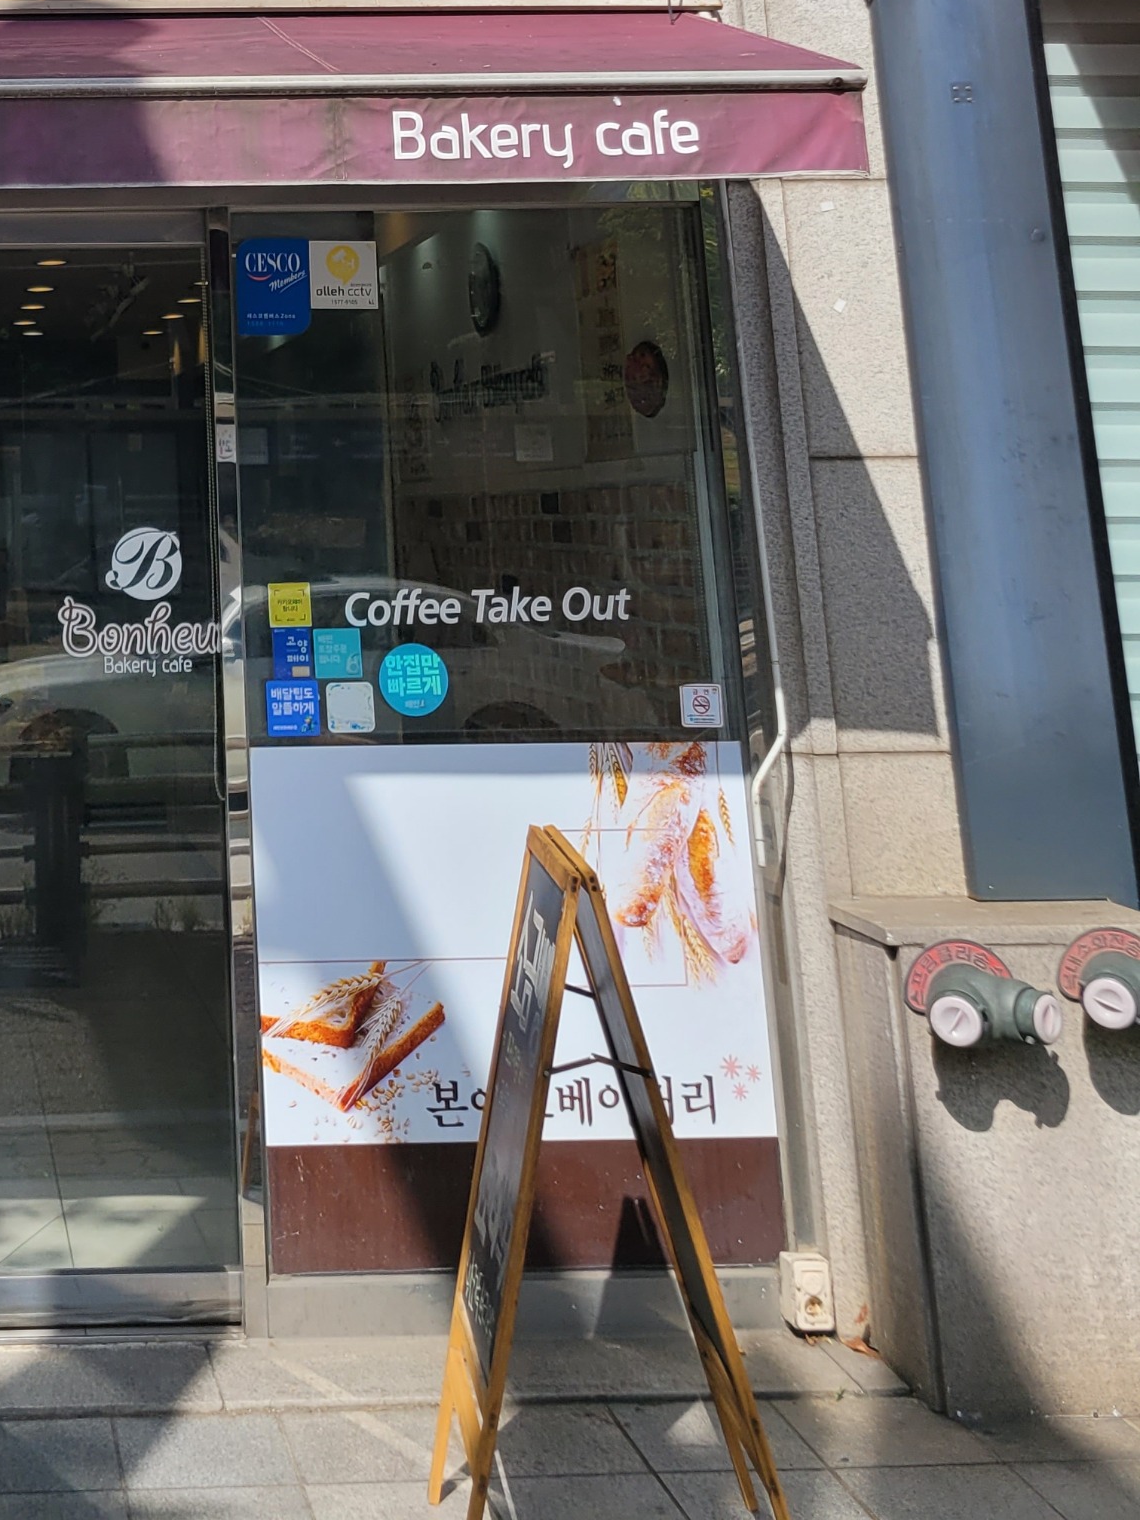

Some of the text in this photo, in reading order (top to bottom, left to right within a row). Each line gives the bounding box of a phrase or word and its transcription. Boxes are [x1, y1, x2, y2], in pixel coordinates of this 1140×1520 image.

[392, 109, 700, 169] Bakery cafe
[245, 252, 301, 273] CESCO
[268, 269, 306, 292] Members
[316, 285, 373, 297] olleh cctv
[344, 585, 632, 627] Coffee Take Out
[104, 655, 193, 678] Bakery cafe
